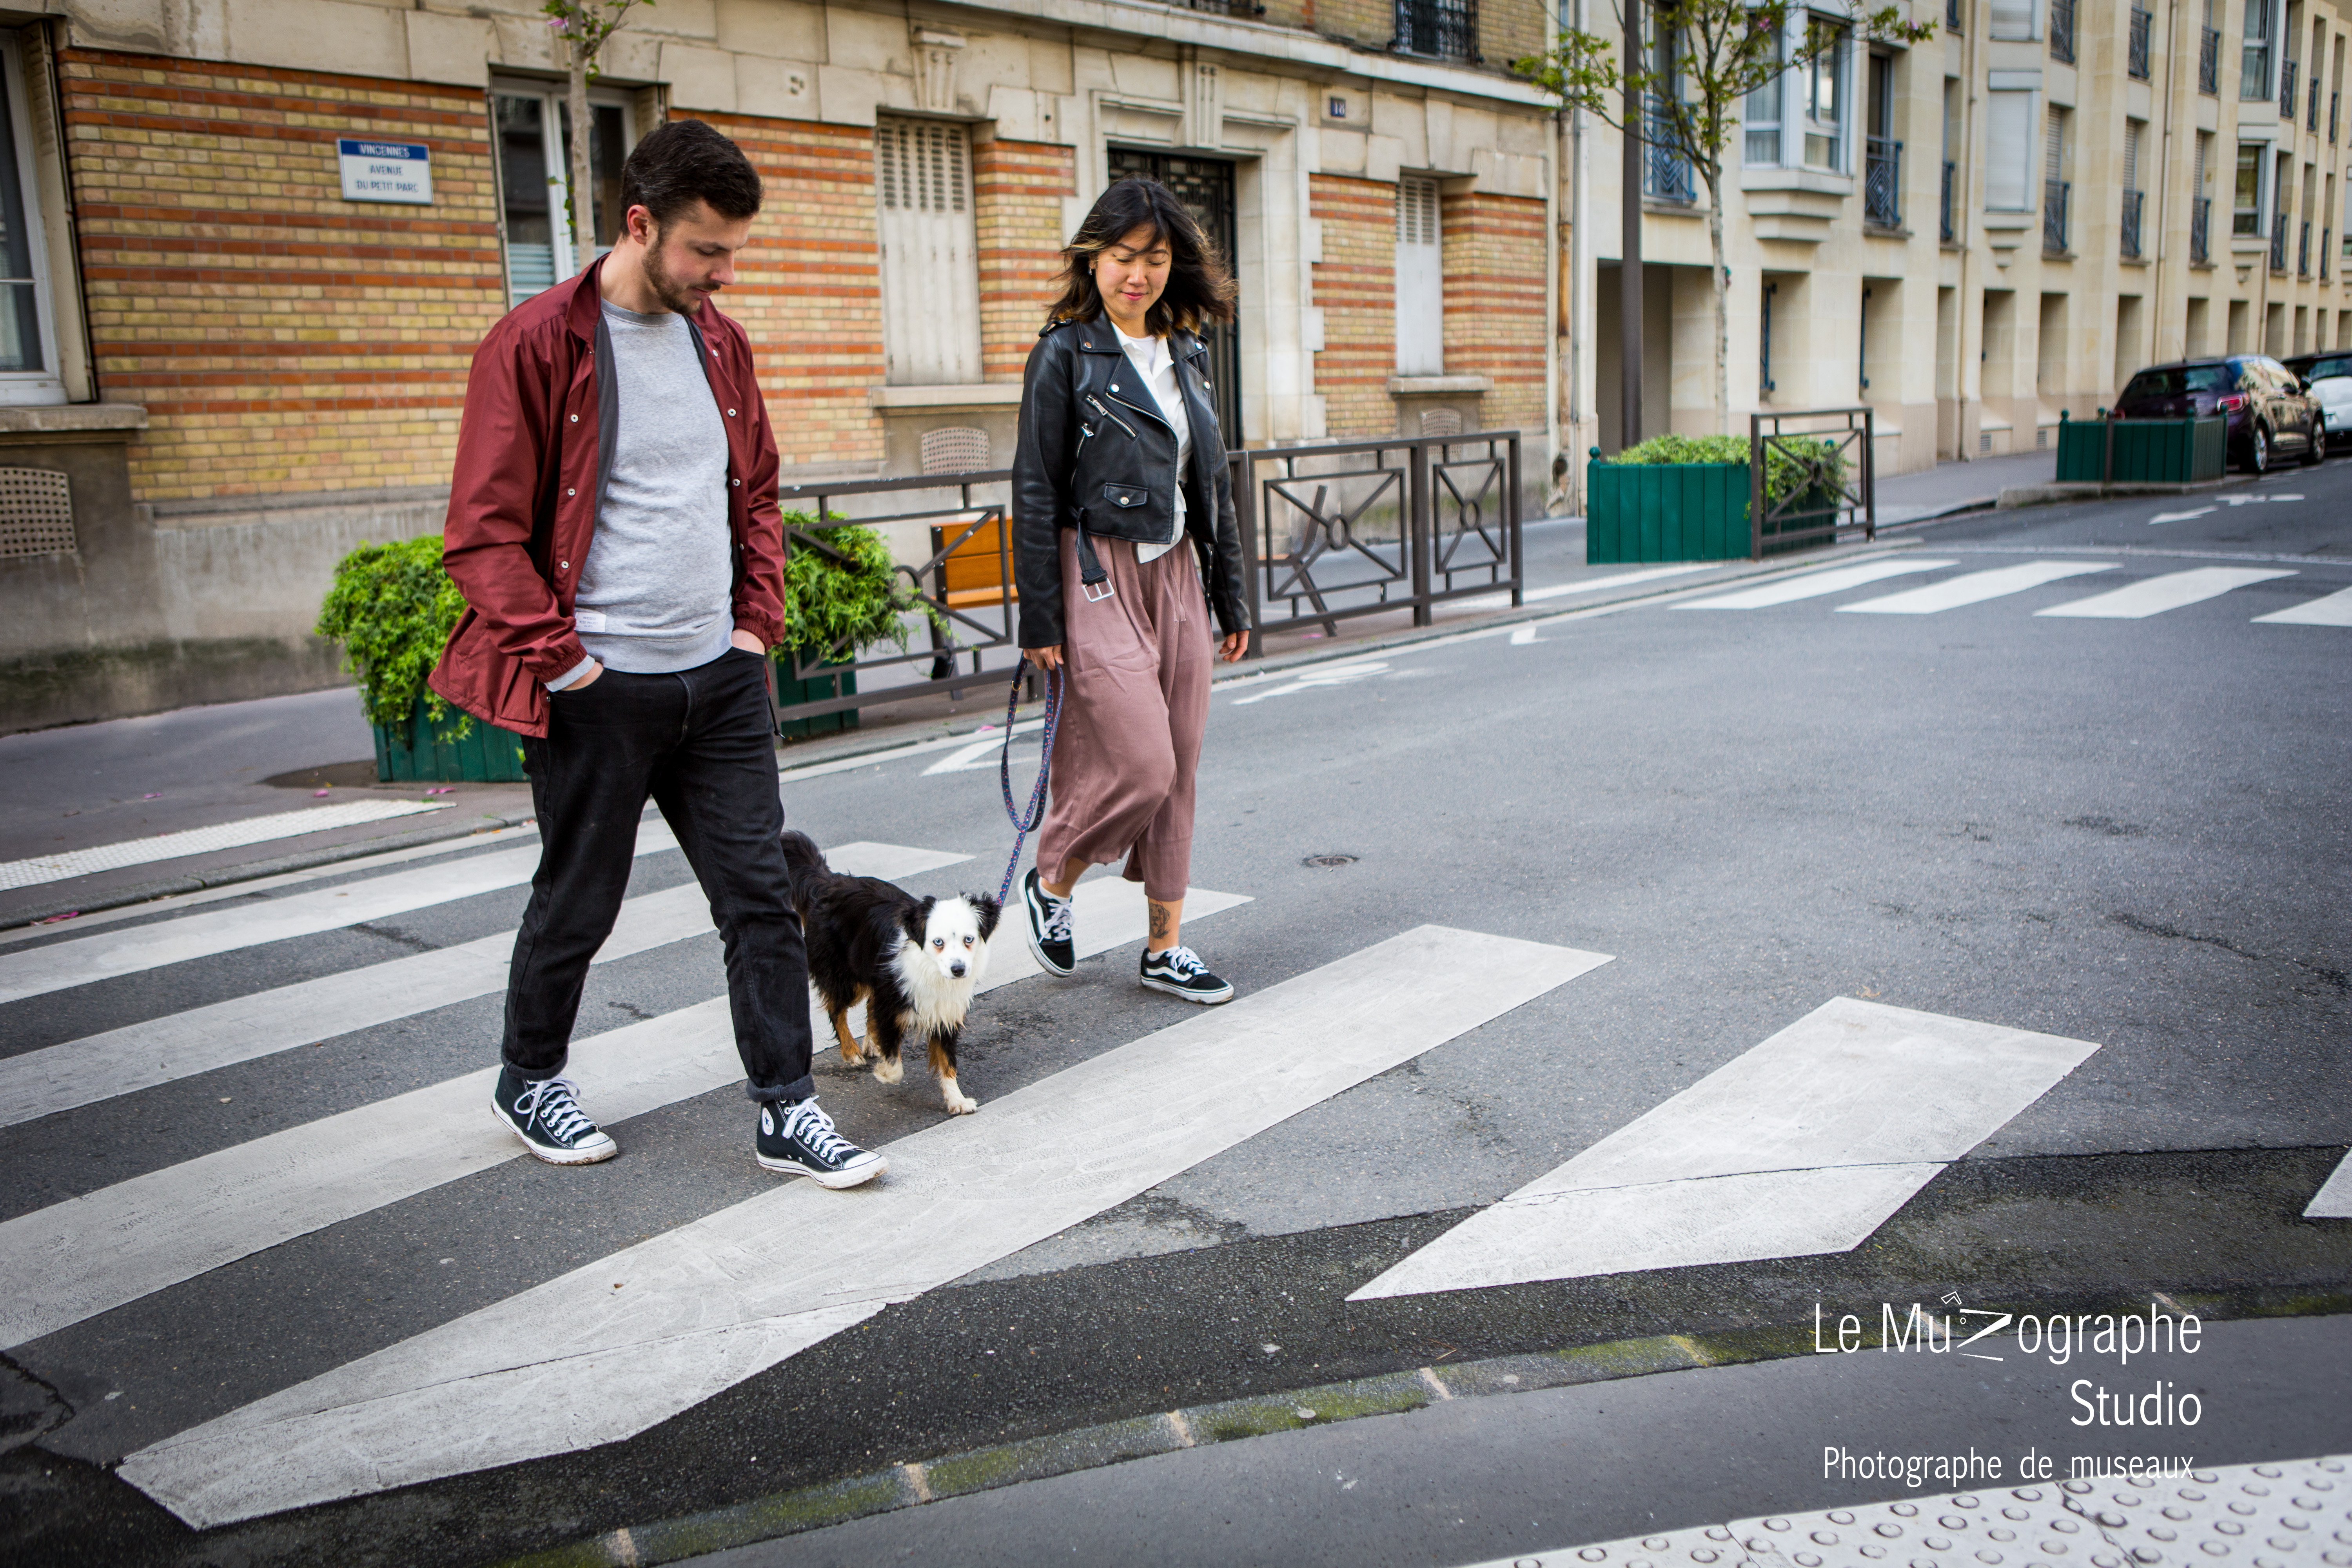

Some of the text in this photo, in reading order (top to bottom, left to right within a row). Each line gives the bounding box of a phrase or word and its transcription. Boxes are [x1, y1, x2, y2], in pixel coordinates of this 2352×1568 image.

[1334, 102, 1345, 116] 18
[359, 143, 410, 158] VINCENNES
[370, 164, 403, 175] AVENUE
[357, 179, 419, 192] DU PETIT PARC
